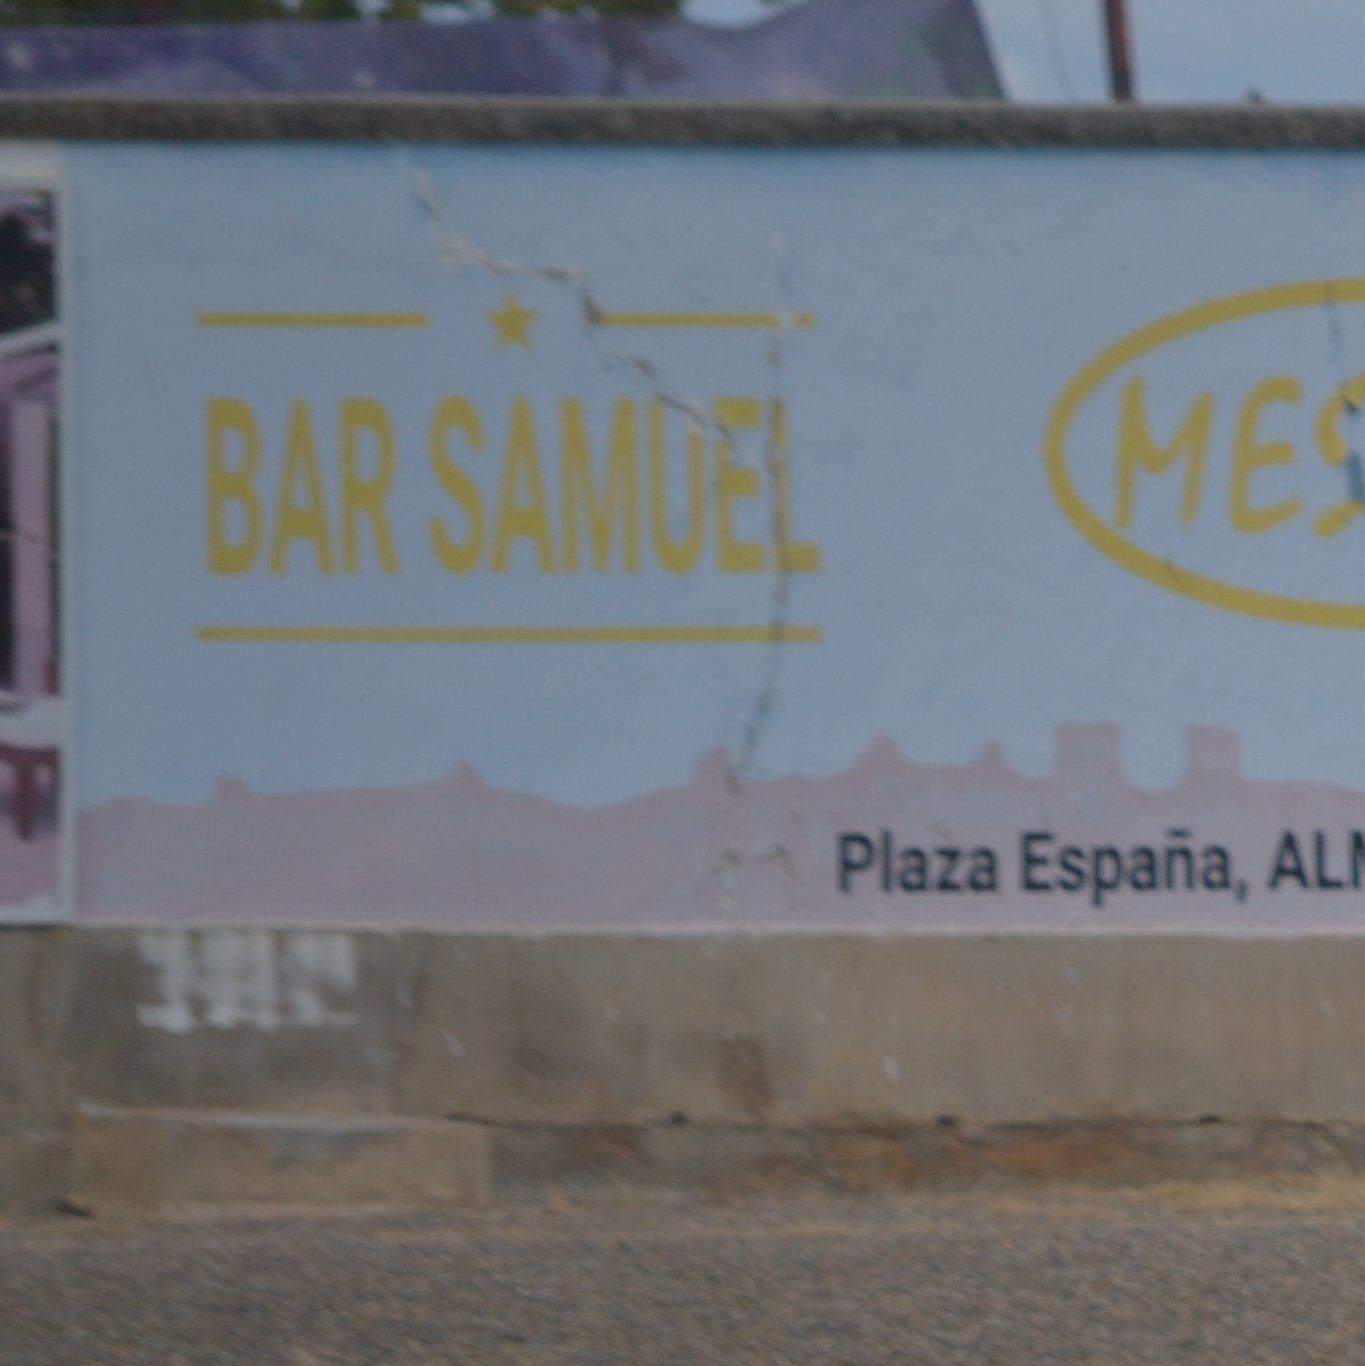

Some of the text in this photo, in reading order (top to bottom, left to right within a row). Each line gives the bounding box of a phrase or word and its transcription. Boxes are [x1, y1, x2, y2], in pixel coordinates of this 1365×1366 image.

[207, 395, 822, 575] BAR SAMUEL
[836, 828, 998, 895] Plaza
[1018, 826, 1249, 908] España,
